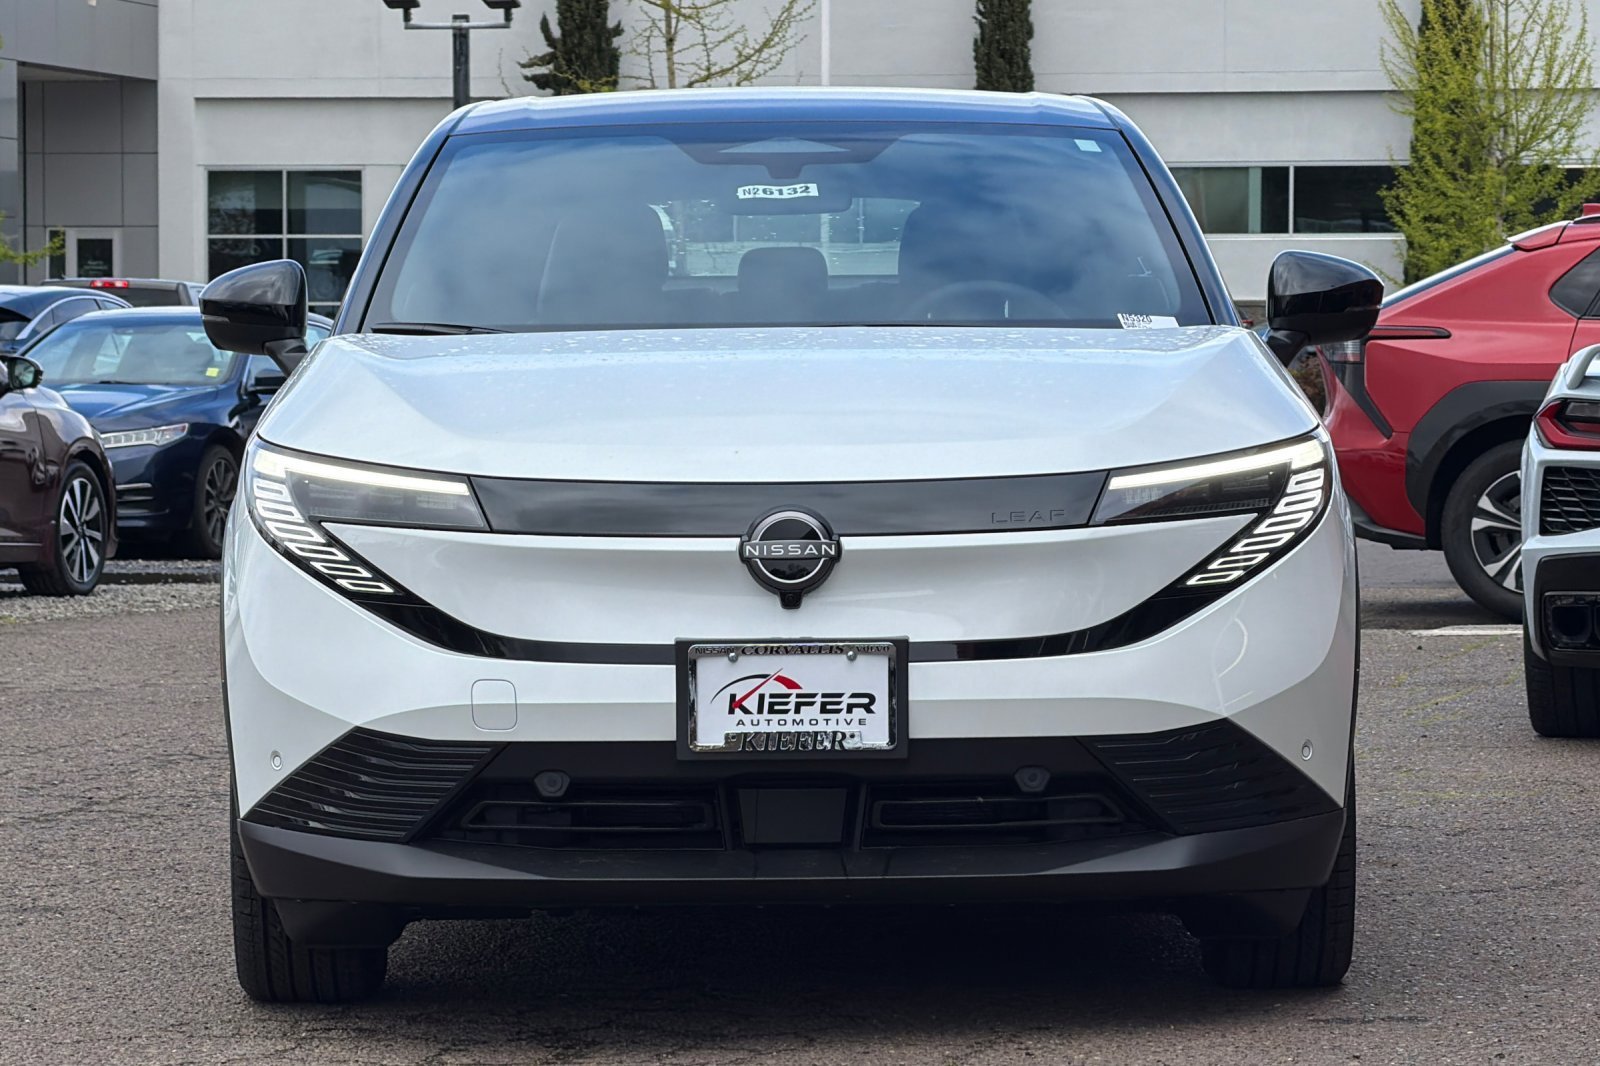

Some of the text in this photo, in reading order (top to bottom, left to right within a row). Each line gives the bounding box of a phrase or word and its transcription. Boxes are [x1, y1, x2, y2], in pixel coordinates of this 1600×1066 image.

[742, 185, 811, 196] N26132
[991, 509, 1065, 524] LEAF
[745, 544, 836, 556] NISSAN
[695, 647, 735, 655] NISSAN
[741, 645, 844, 655] CORVALLIS
[727, 692, 876, 715] KIEFER
[736, 718, 867, 727] AUTOMOTIVE
[738, 731, 847, 750] KIEFER
